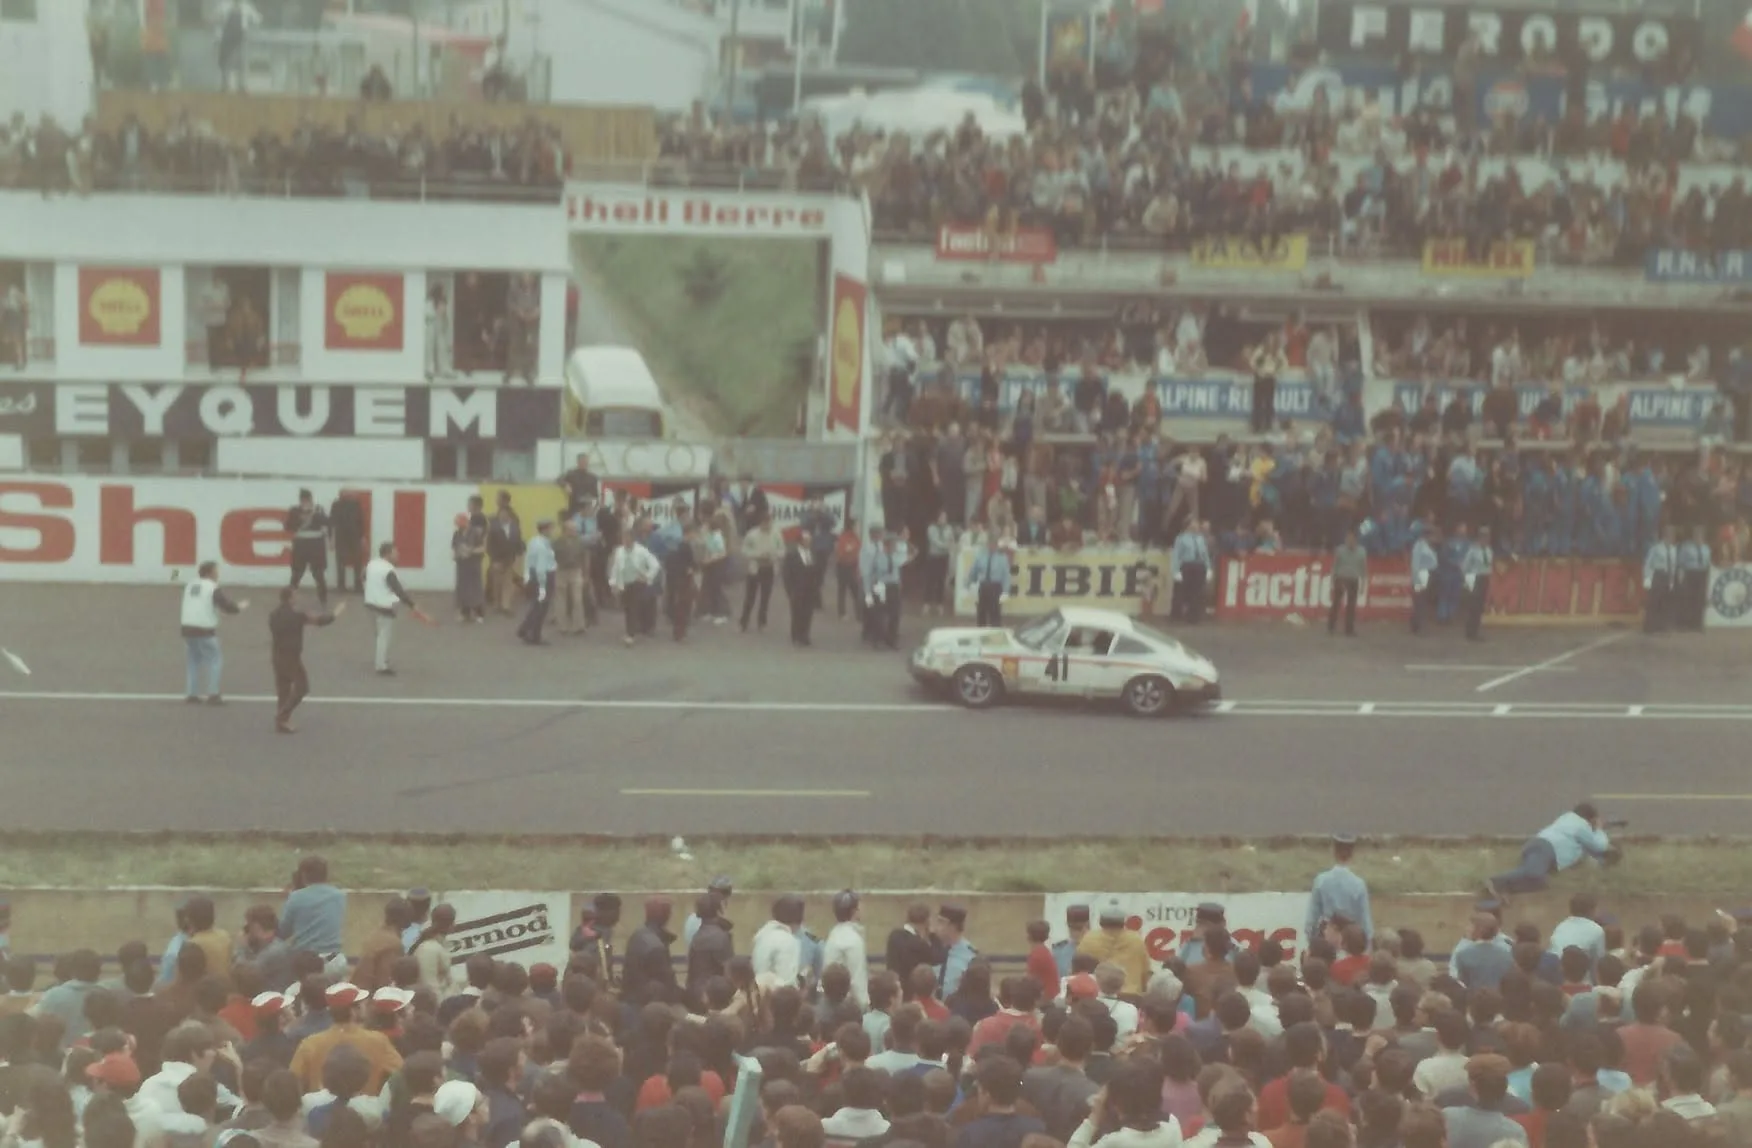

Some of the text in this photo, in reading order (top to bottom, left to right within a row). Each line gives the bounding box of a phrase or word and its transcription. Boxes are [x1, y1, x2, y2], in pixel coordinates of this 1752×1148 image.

[56, 384, 497, 437] EYQUEM
[1044, 653, 1069, 682] 41
[443, 914, 551, 953] ernod
